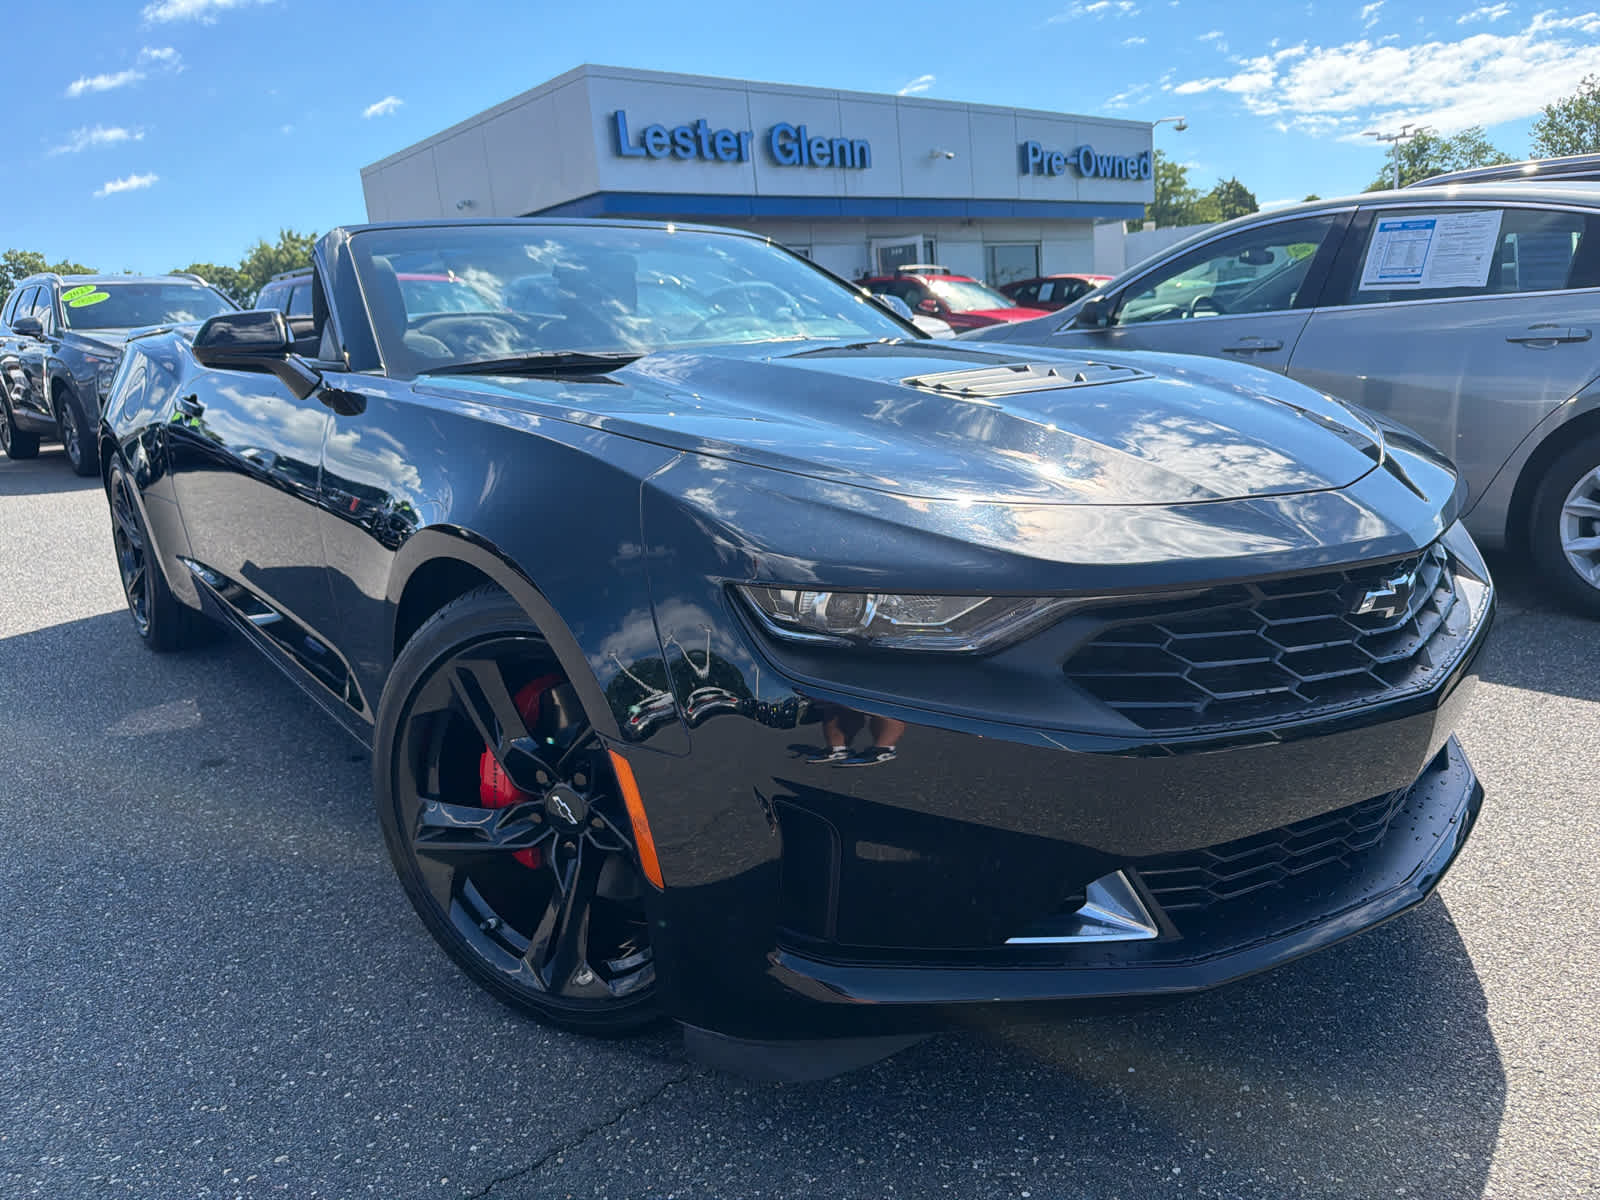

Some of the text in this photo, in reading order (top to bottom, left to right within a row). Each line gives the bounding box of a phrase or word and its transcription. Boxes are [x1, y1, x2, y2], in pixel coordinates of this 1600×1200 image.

[613, 110, 871, 169] Lester Glenn
[1024, 140, 1152, 181] Pre-Owned
